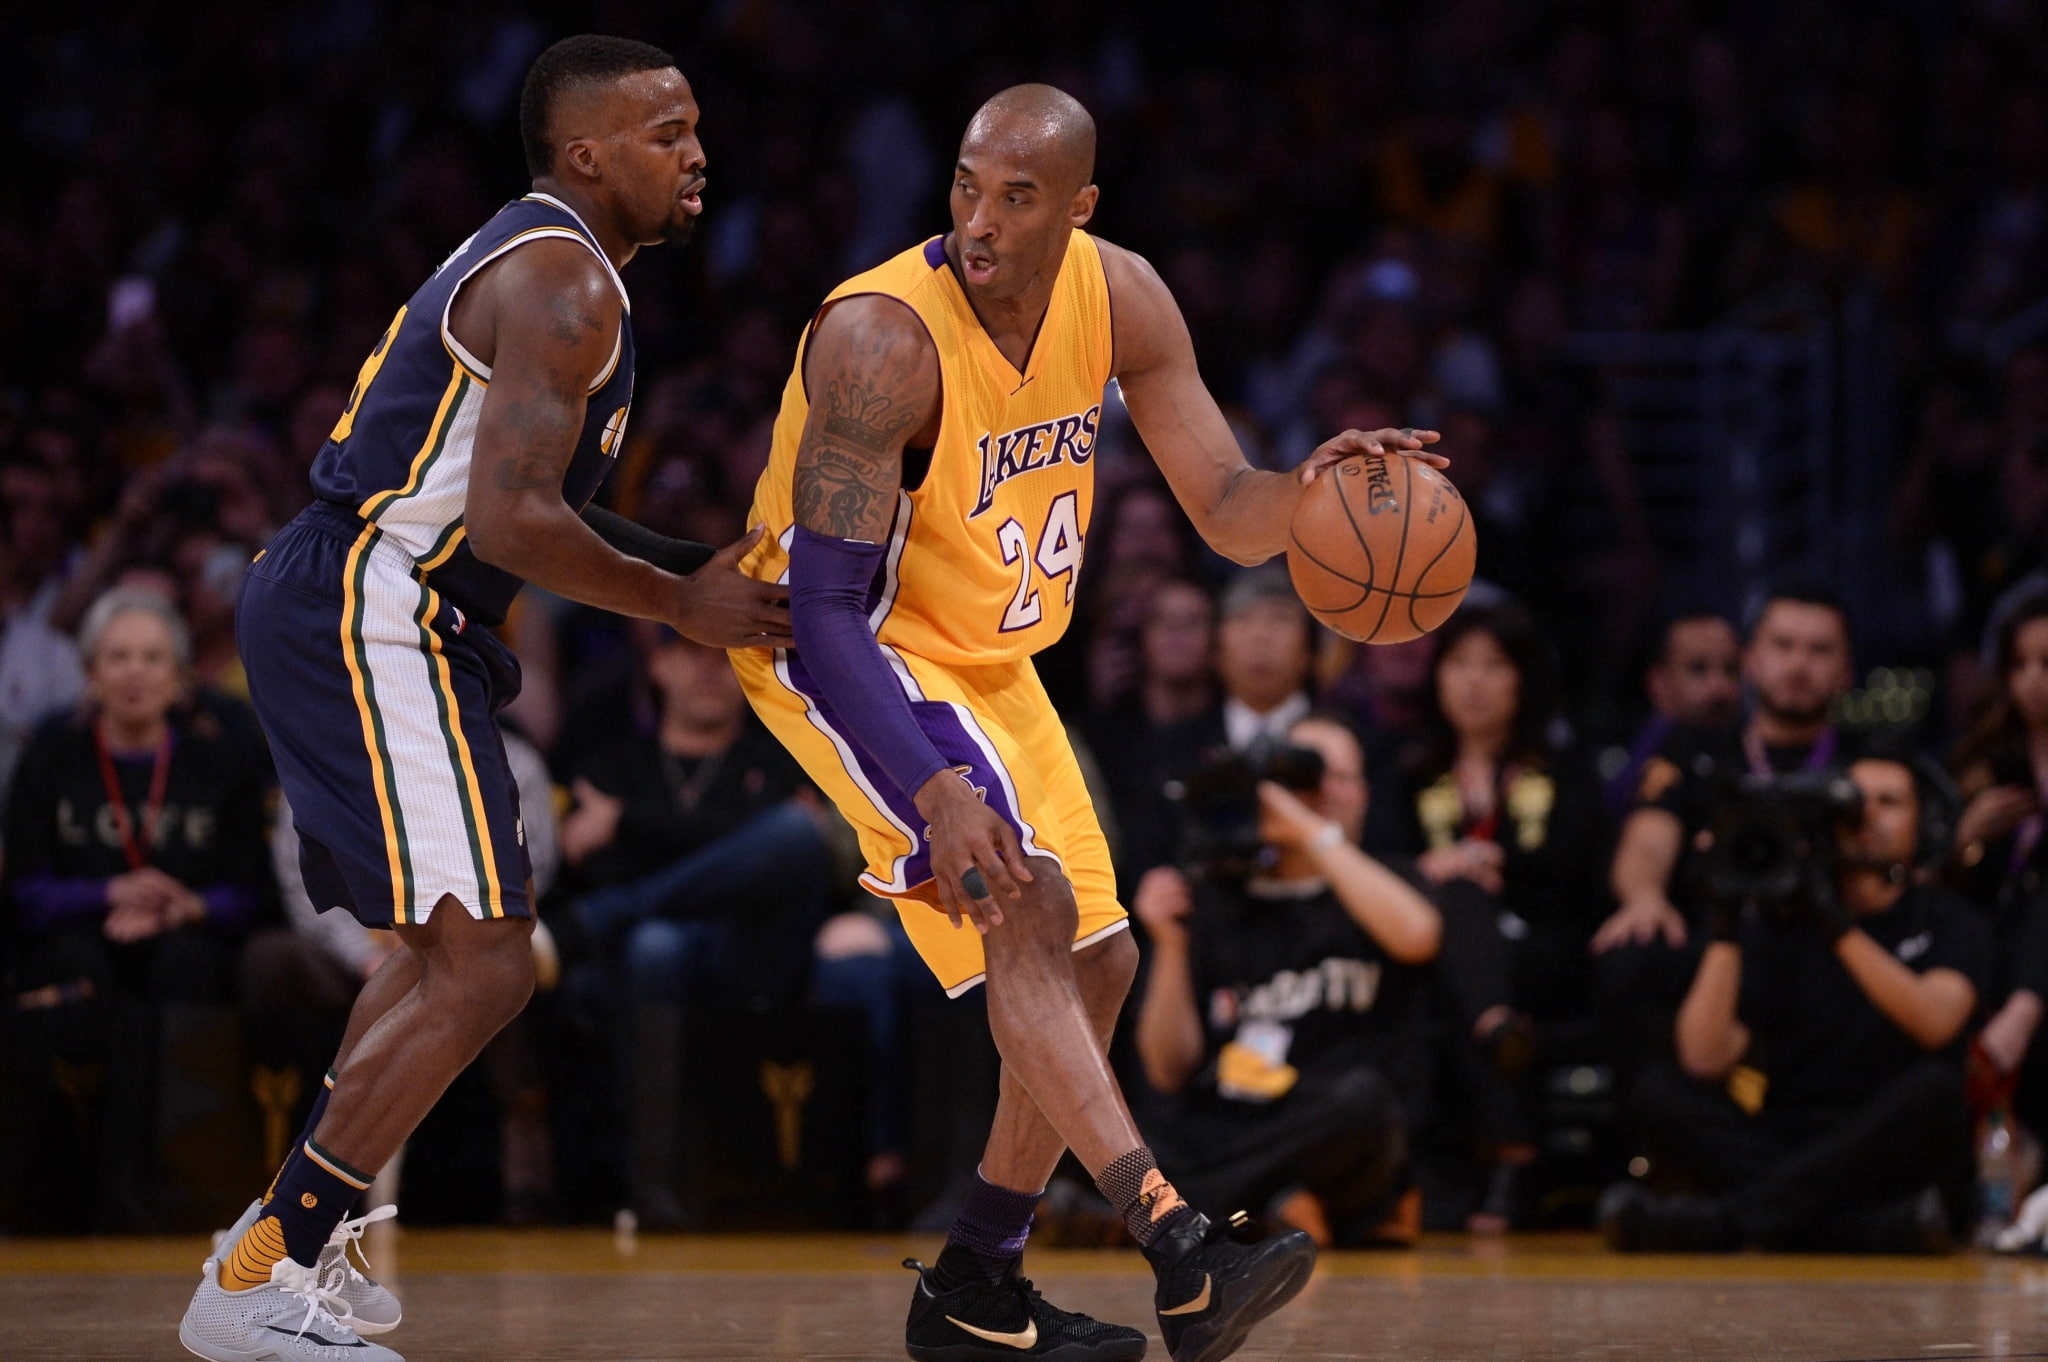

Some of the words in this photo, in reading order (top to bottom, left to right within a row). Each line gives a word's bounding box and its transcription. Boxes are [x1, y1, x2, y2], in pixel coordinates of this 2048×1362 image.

[967, 404, 1100, 521] LAKERS
[1365, 451, 1400, 517] SPALD
[996, 490, 1083, 633] 24
